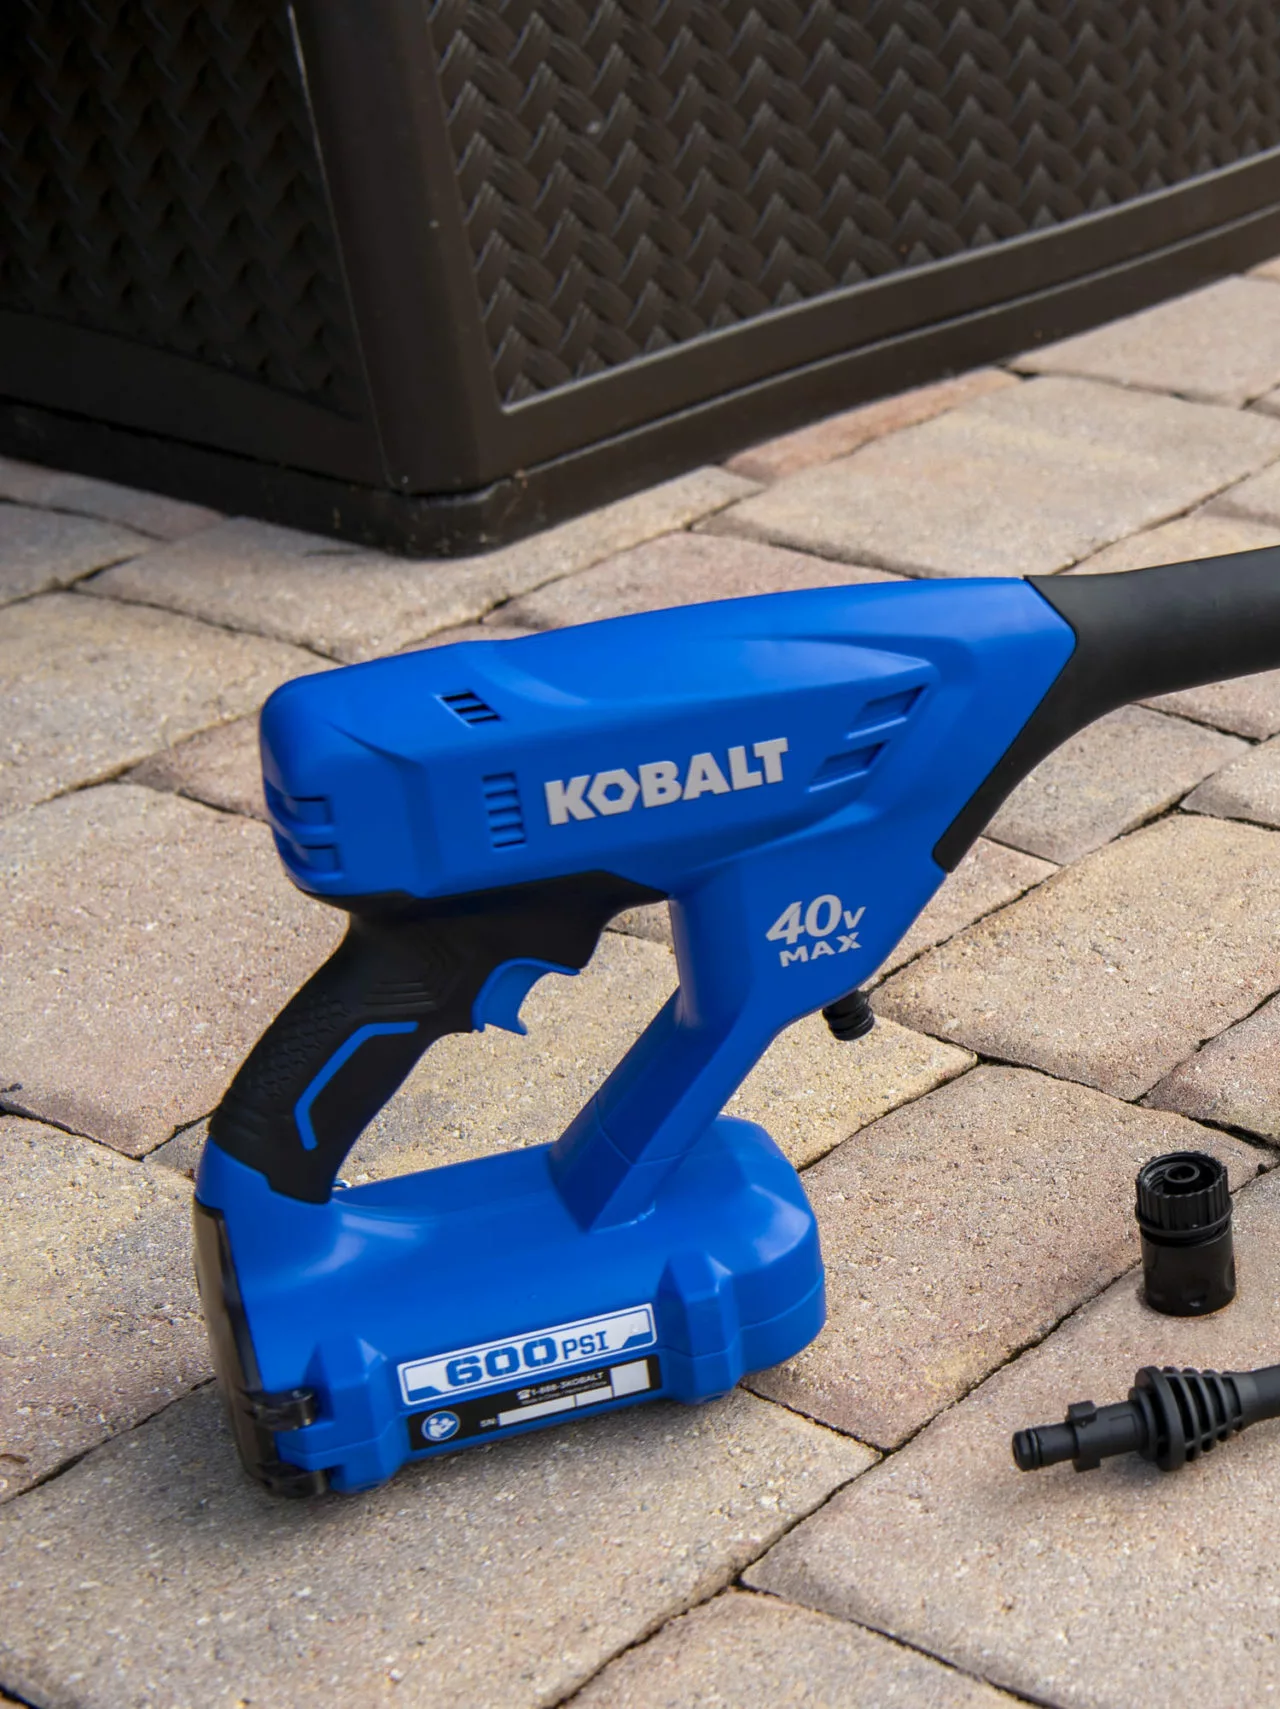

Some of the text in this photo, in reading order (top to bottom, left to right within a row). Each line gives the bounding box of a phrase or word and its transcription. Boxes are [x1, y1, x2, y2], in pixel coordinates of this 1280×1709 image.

[545, 738, 788, 825] KOBALT
[779, 932, 862, 967] MAX
[445, 1331, 609, 1387] 600 PSI
